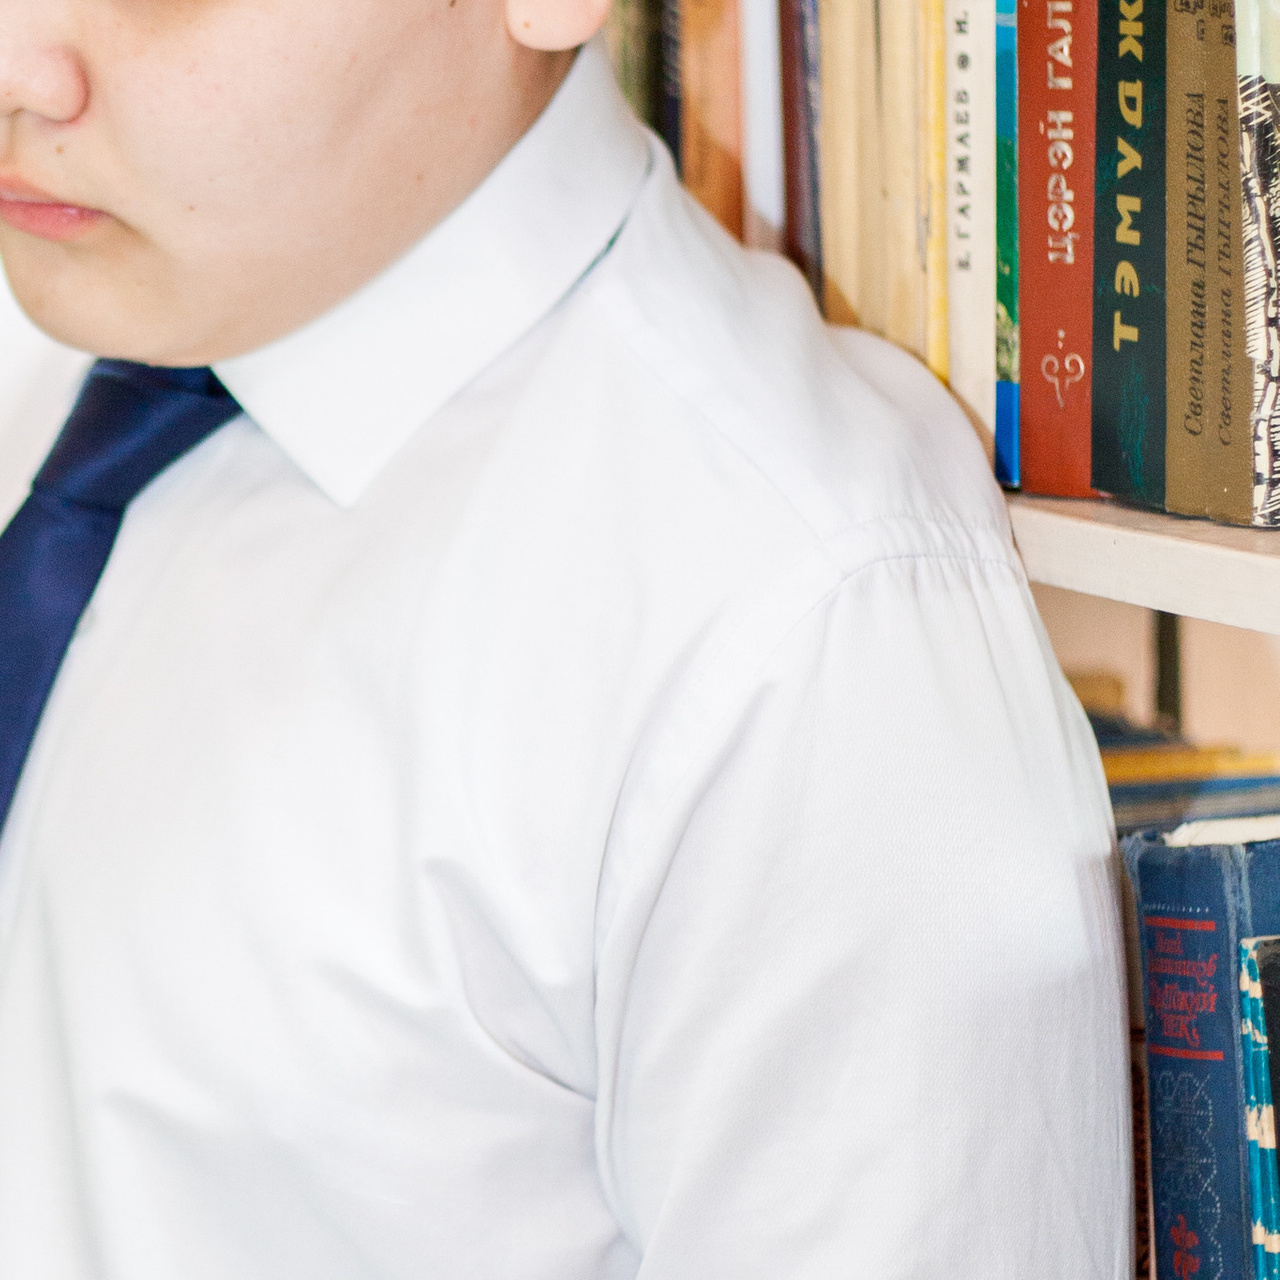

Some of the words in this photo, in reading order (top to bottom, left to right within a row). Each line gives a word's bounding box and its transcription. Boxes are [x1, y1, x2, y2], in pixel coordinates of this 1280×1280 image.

[1045, 109, 1075, 265] ЦЭРЭН
[1182, 89, 1207, 270] ГЫРЫЛОВА
[1180, 278, 1207, 438] Светлана
[1213, 287, 1235, 448] Светлана
